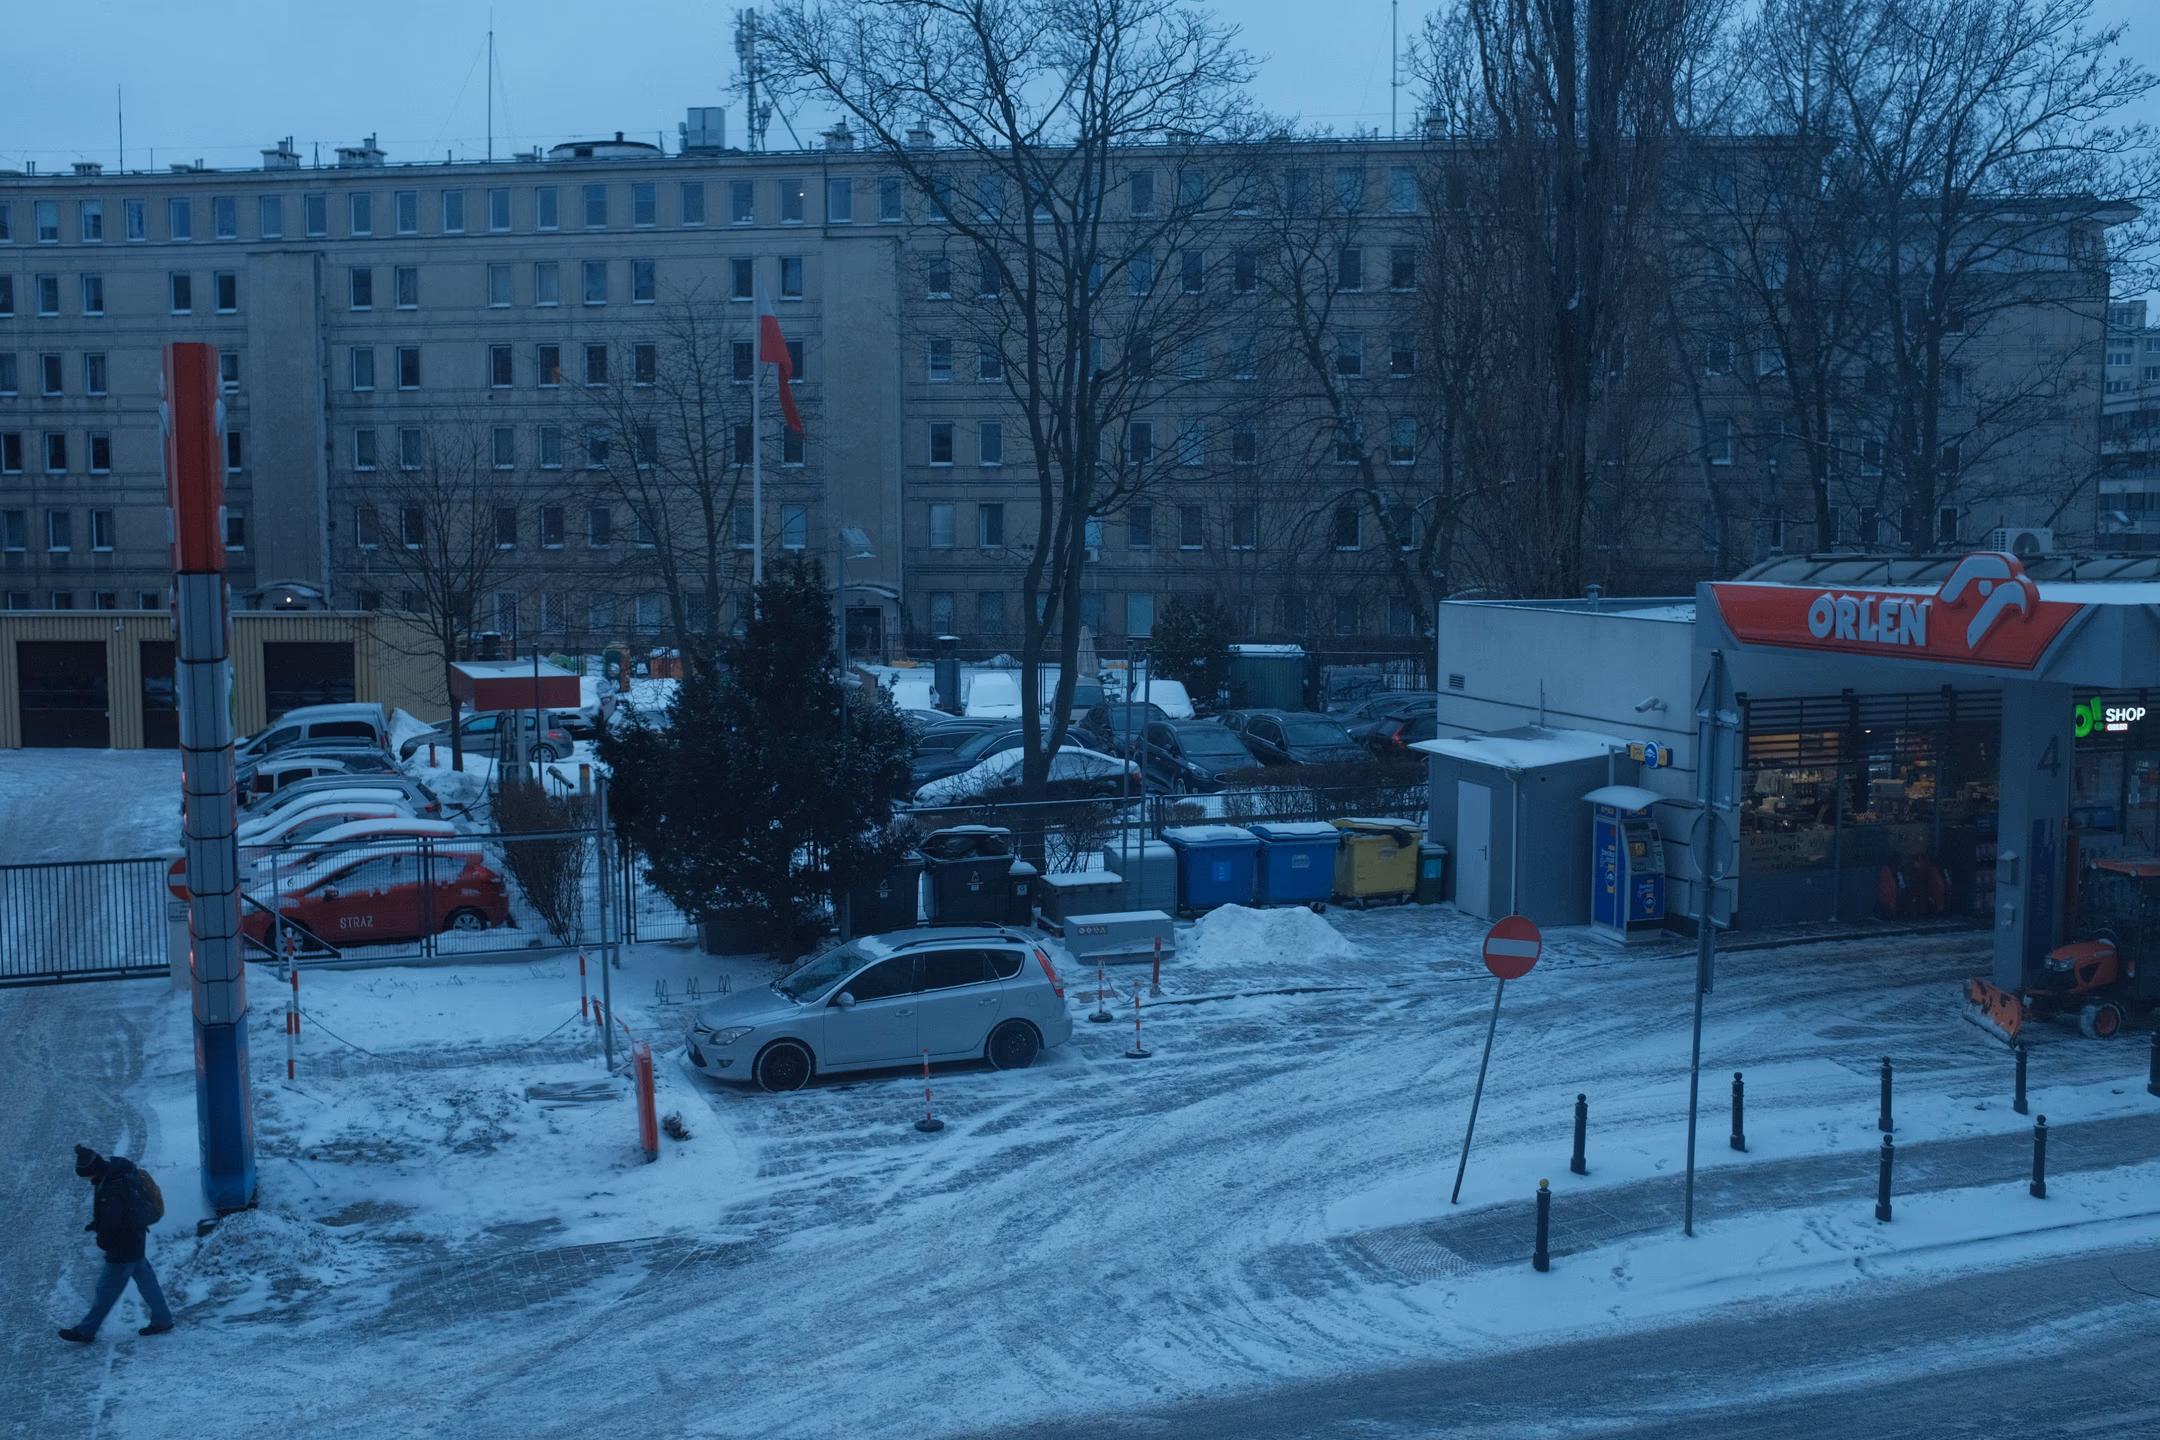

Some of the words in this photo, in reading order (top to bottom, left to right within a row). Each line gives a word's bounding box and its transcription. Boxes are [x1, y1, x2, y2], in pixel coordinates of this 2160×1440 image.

[1808, 595, 1930, 646] ORLEN
[2105, 707, 2146, 722] SHOP
[2037, 735, 2061, 777] 4
